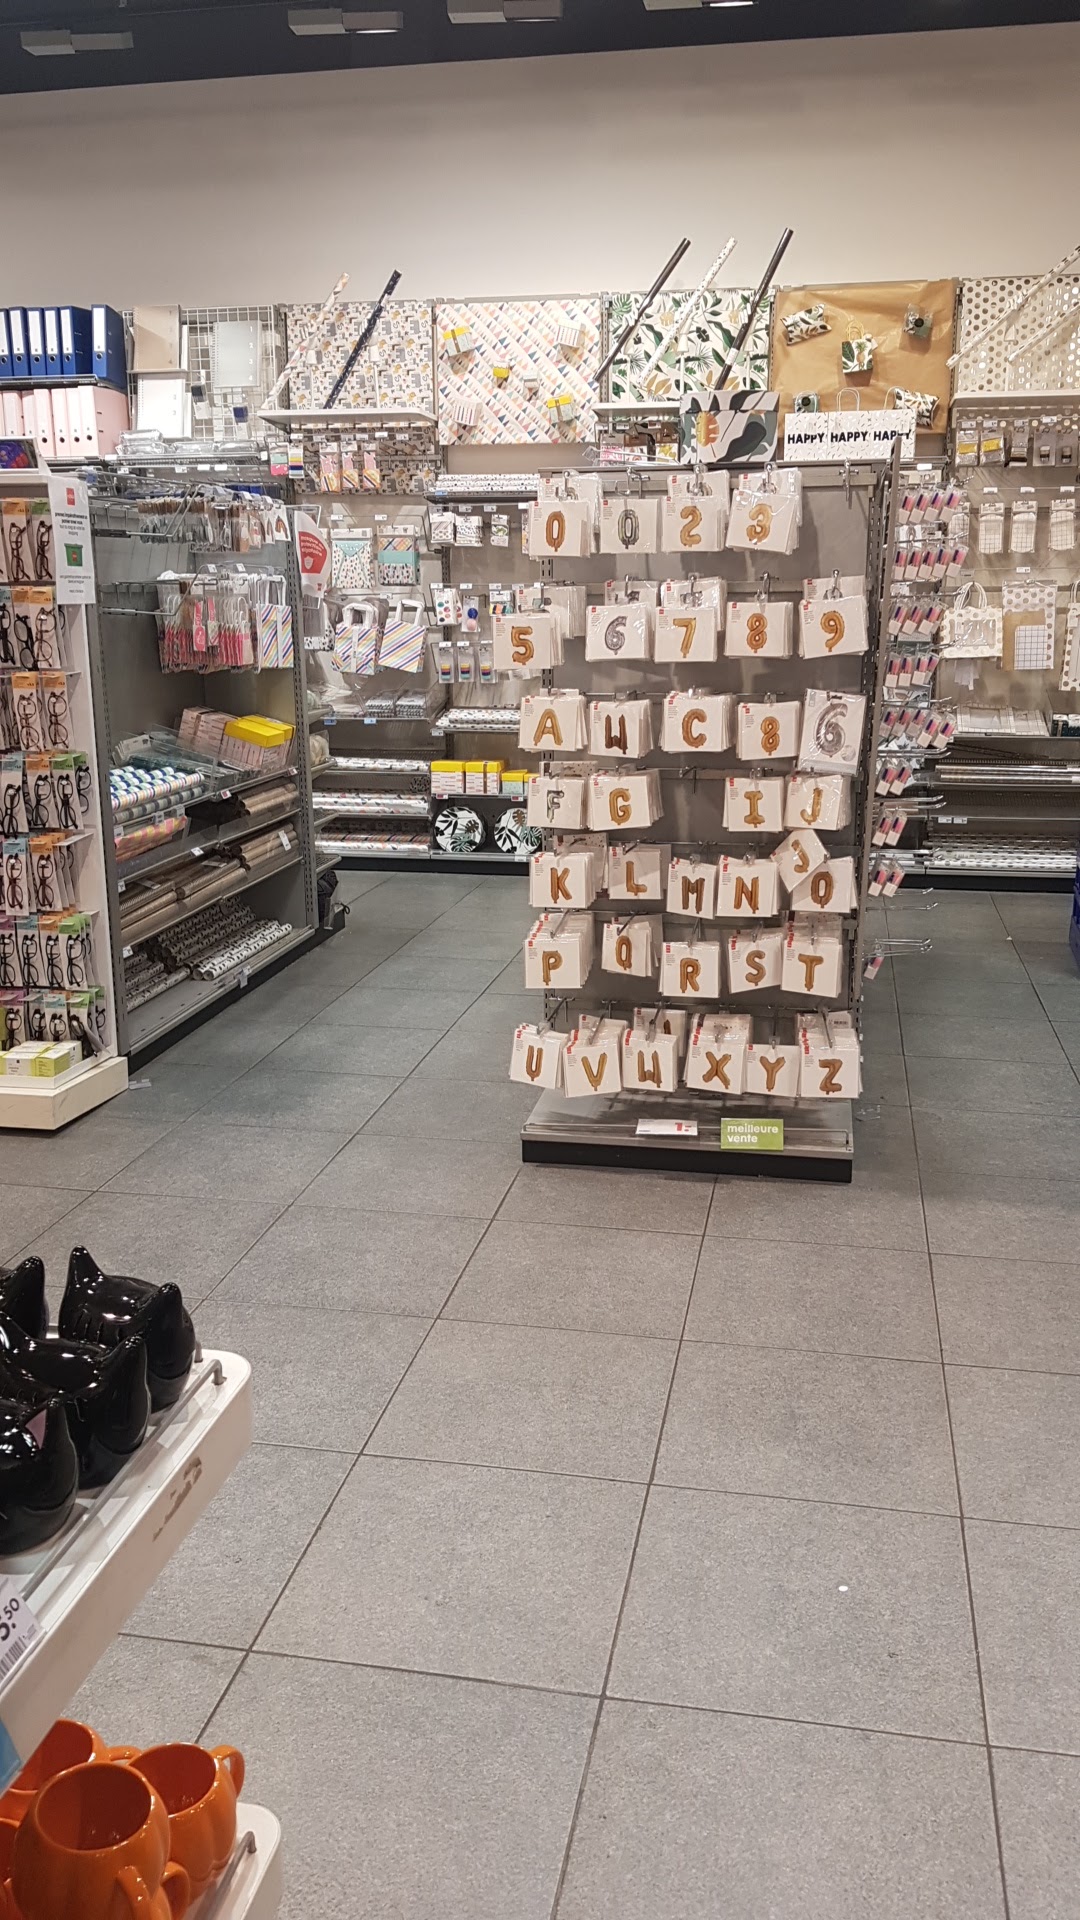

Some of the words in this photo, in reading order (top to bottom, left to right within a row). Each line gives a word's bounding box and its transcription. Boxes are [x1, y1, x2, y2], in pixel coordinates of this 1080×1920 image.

[788, 433, 825, 444] HAPPY
[831, 431, 868, 442] HAPPY
[873, 429, 911, 441] HAPY
[680, 505, 702, 547] 2
[746, 503, 773, 545] 3
[511, 626, 534, 665] 5
[604, 615, 628, 655] 6
[673, 617, 697, 658] 7
[746, 613, 768, 653] 8
[820, 610, 845, 653] 9
[533, 708, 563, 746] A
[681, 708, 707, 748] C
[760, 716, 780, 754] 8
[813, 703, 848, 758] 6
[546, 790, 565, 823] F
[608, 788, 632, 825] G
[743, 791, 765, 828] I
[800, 788, 824, 825] J
[791, 839, 809, 873] J
[550, 867, 571, 904] K
[626, 860, 647, 896] L
[681, 876, 705, 913] M
[734, 876, 759, 914] N
[542, 950, 562, 986] P
[680, 957, 700, 993] R
[745, 950, 767, 986] S
[798, 954, 824, 991] T
[525, 1045, 543, 1082] U
[581, 1052, 607, 1092] V
[637, 1050, 662, 1088] W
[702, 1051, 732, 1088] X
[760, 1056, 785, 1092] Y
[818, 1058, 843, 1095] Z
[727, 1123, 779, 1133] meilleure
[727, 1134, 758, 1143] vente
